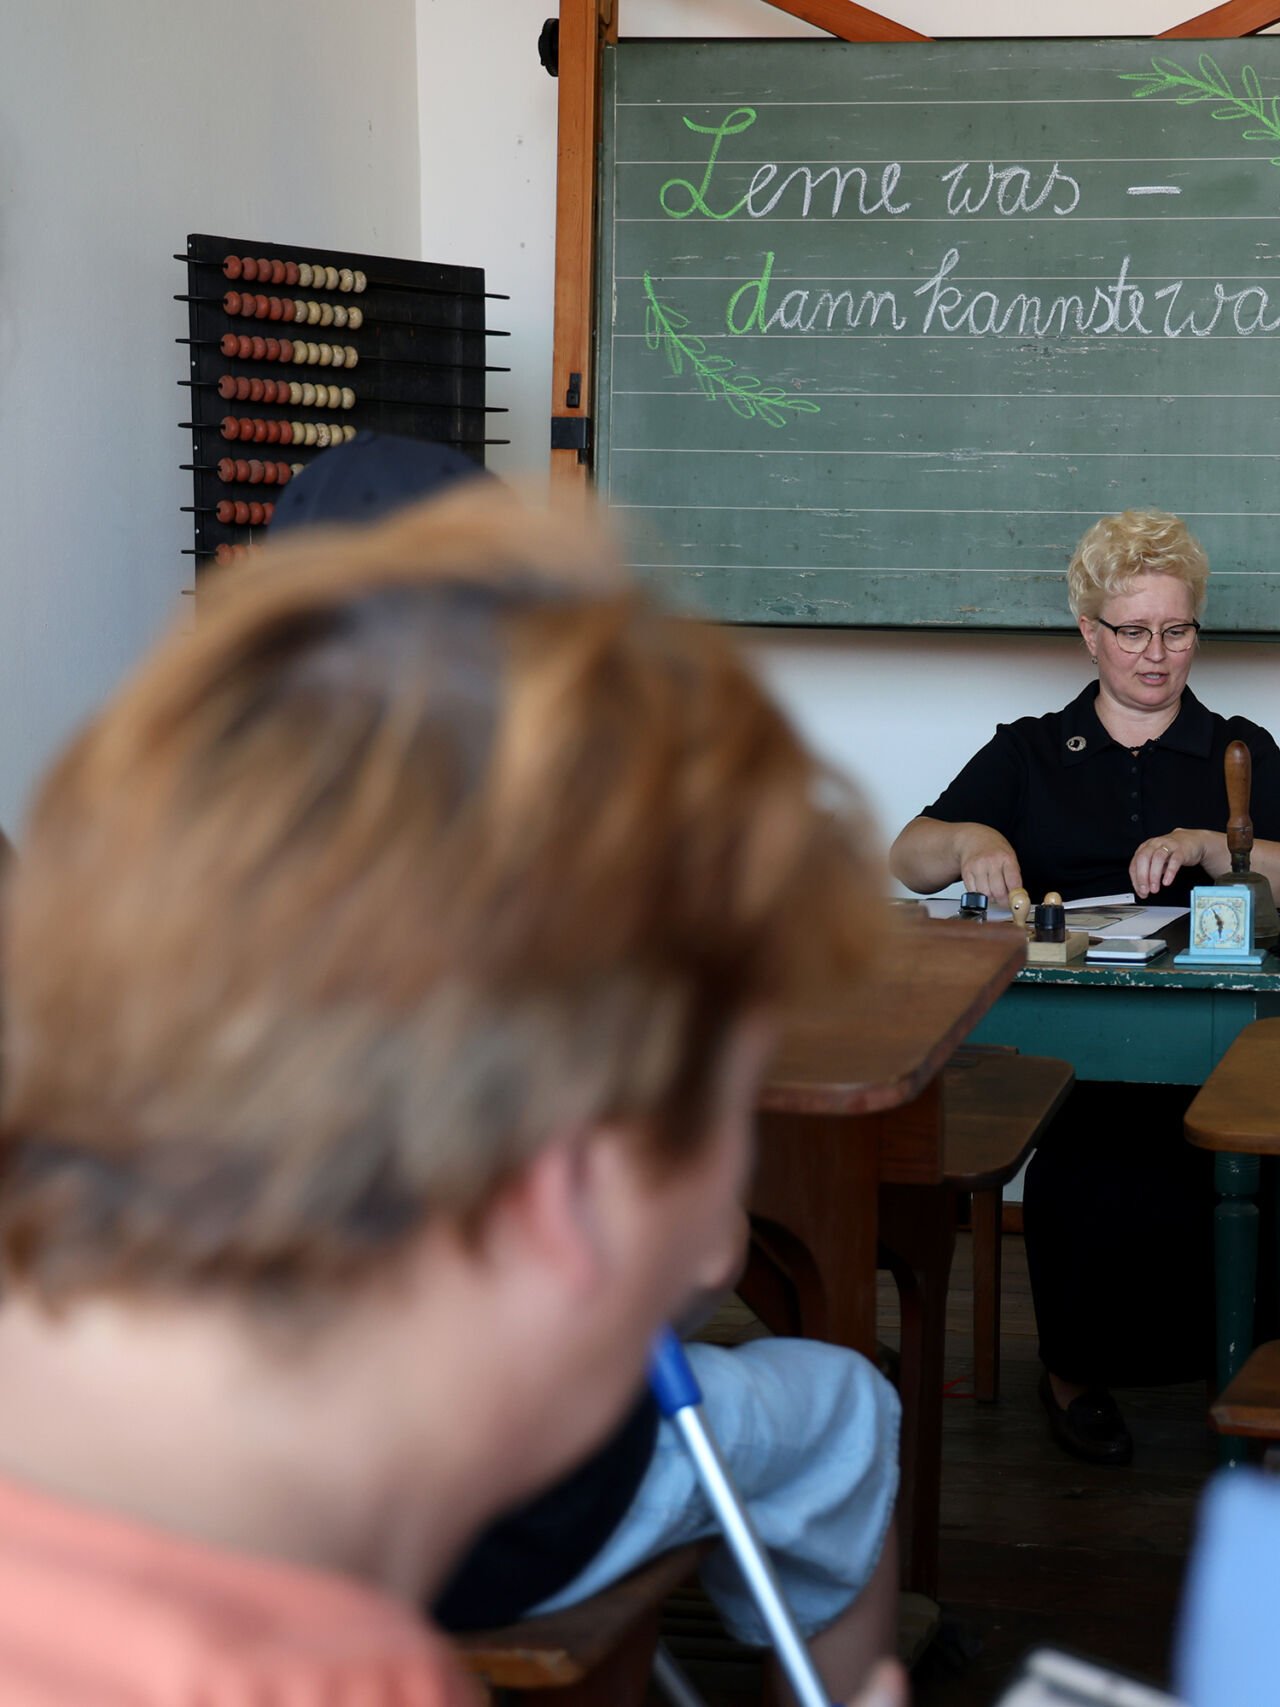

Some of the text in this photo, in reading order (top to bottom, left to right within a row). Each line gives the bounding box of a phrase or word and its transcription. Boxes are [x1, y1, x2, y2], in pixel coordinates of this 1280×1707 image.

[941, 161, 1080, 216] was
[727, 251, 907, 334] dann
[914, 248, 1152, 334] kannste
